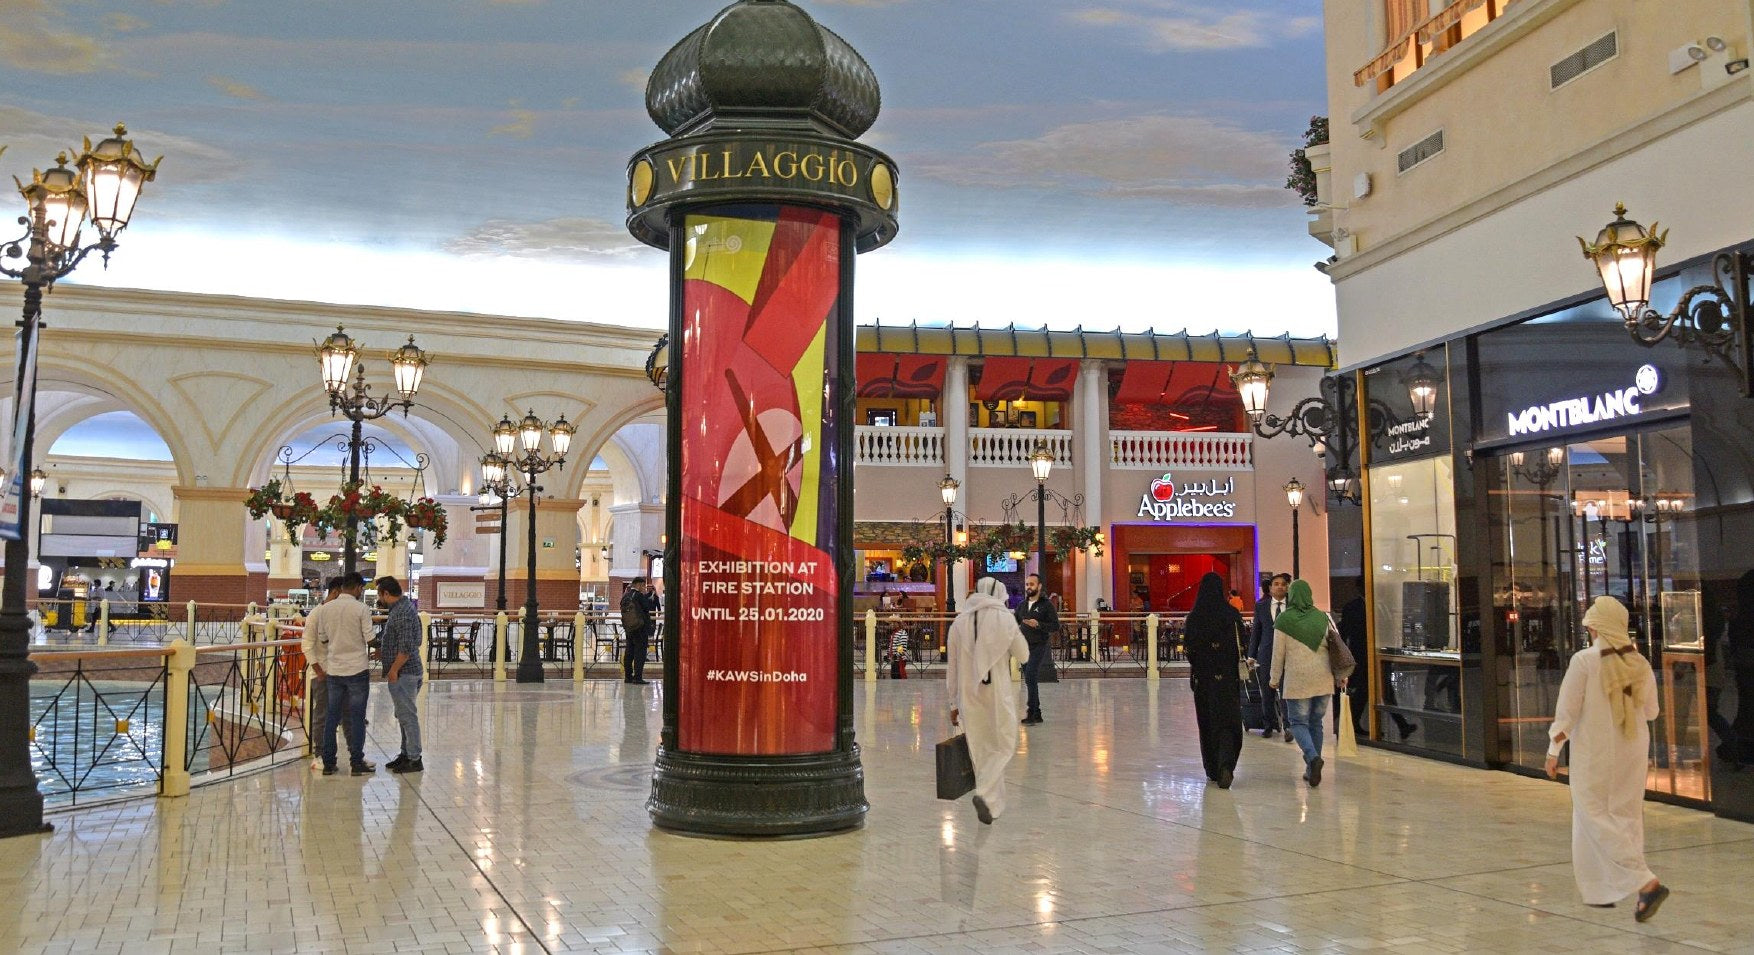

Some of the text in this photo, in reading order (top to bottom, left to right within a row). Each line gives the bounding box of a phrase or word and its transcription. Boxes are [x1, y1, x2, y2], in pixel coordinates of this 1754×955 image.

[667, 151, 859, 187] VILLAGGIO
[1507, 386, 1640, 436] MONTBLANC
[1387, 418, 1430, 437] MONTBLANC
[1137, 494, 1236, 521] Applebee's
[698, 561, 818, 575] EXHIBITION AT
[443, 591, 482, 599] VILLAGGIO
[702, 582, 814, 595] FIRE STATION
[691, 607, 825, 621] UNTIL 25.01.2020
[706, 669, 807, 683] #KAWSinDoha
